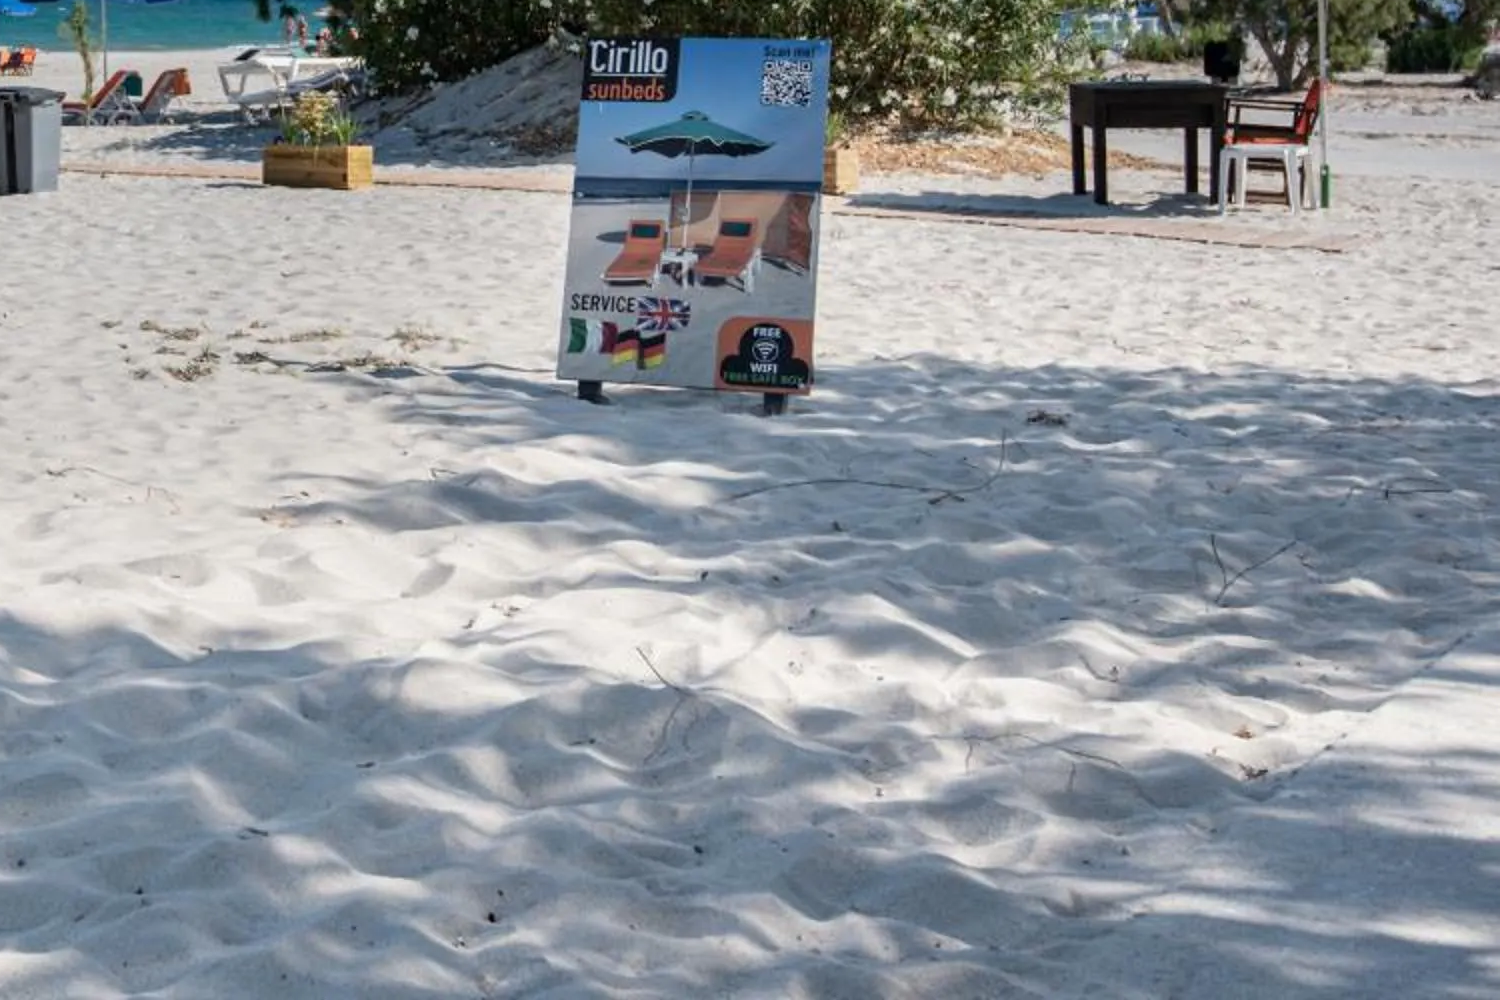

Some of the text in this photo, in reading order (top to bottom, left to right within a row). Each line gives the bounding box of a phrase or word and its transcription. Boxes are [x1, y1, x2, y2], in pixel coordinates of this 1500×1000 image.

[590, 40, 669, 73] Cirillo
[588, 78, 666, 100] sunbeds
[571, 293, 637, 313] SERVICE
[753, 327, 781, 338] FREE
[749, 361, 778, 374] WIFI
